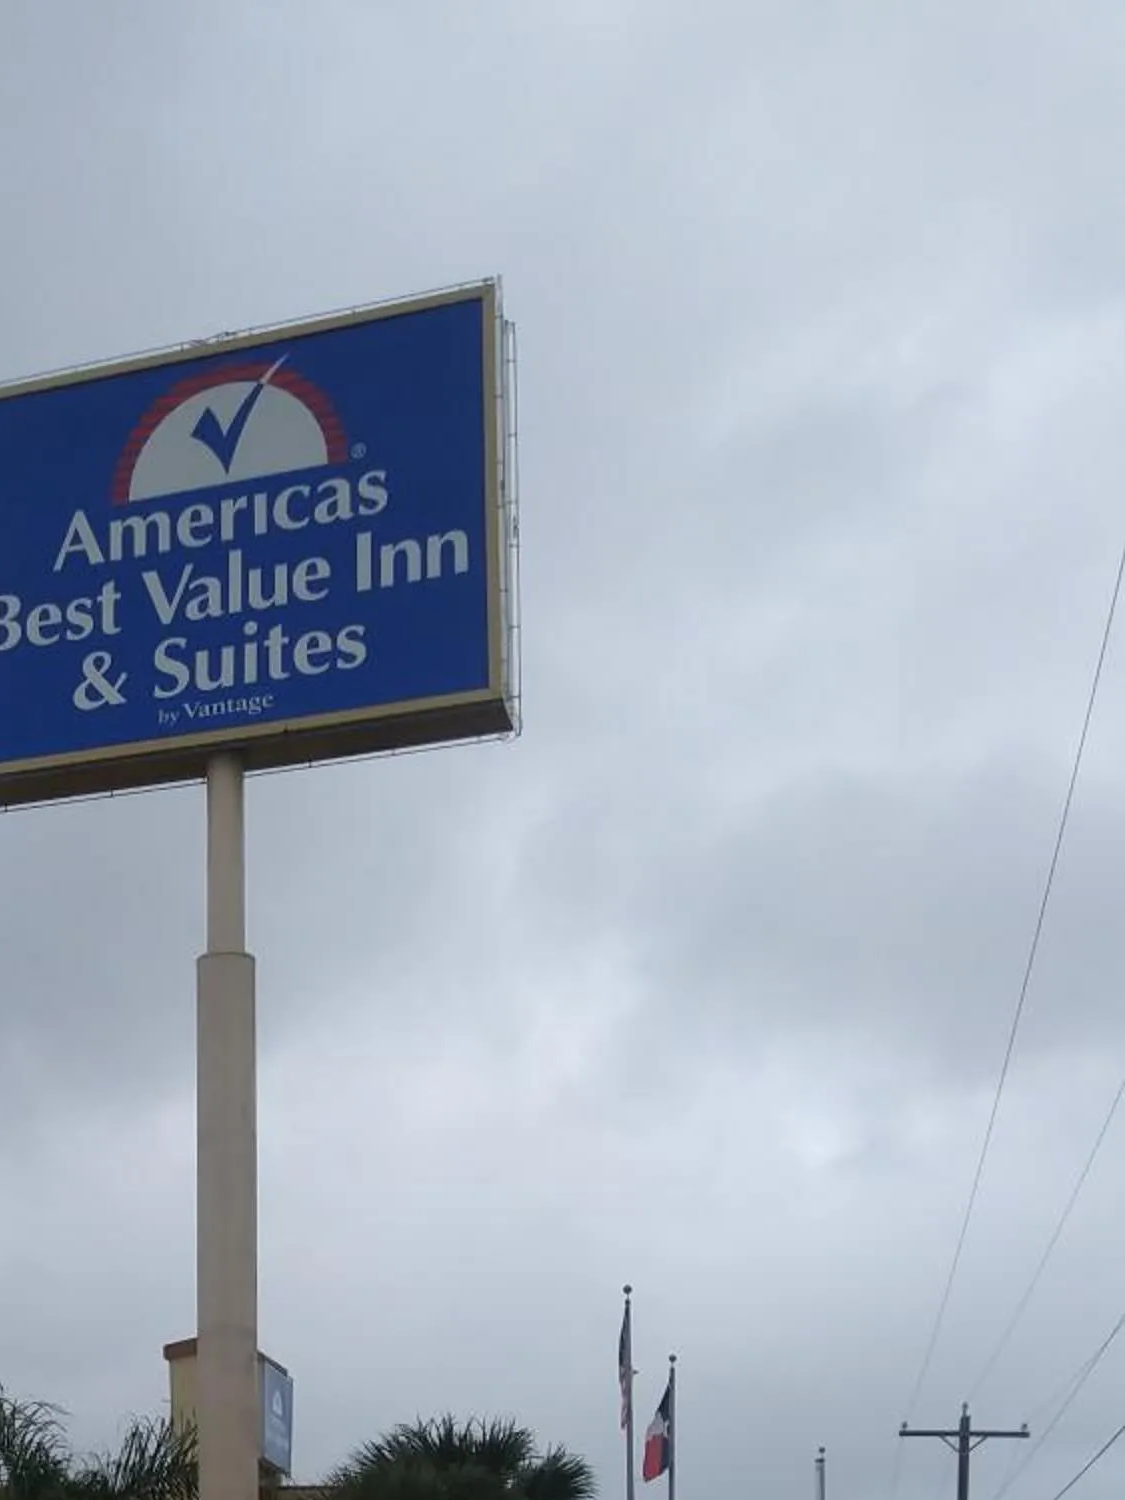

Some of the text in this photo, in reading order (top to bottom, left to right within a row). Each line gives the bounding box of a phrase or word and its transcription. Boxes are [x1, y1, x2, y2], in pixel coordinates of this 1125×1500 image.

[53, 468, 389, 571] Americas
[142, 549, 330, 625] Value
[355, 529, 470, 592] Inn
[73, 621, 366, 711] & Suites
[158, 694, 274, 727] by Vantage
